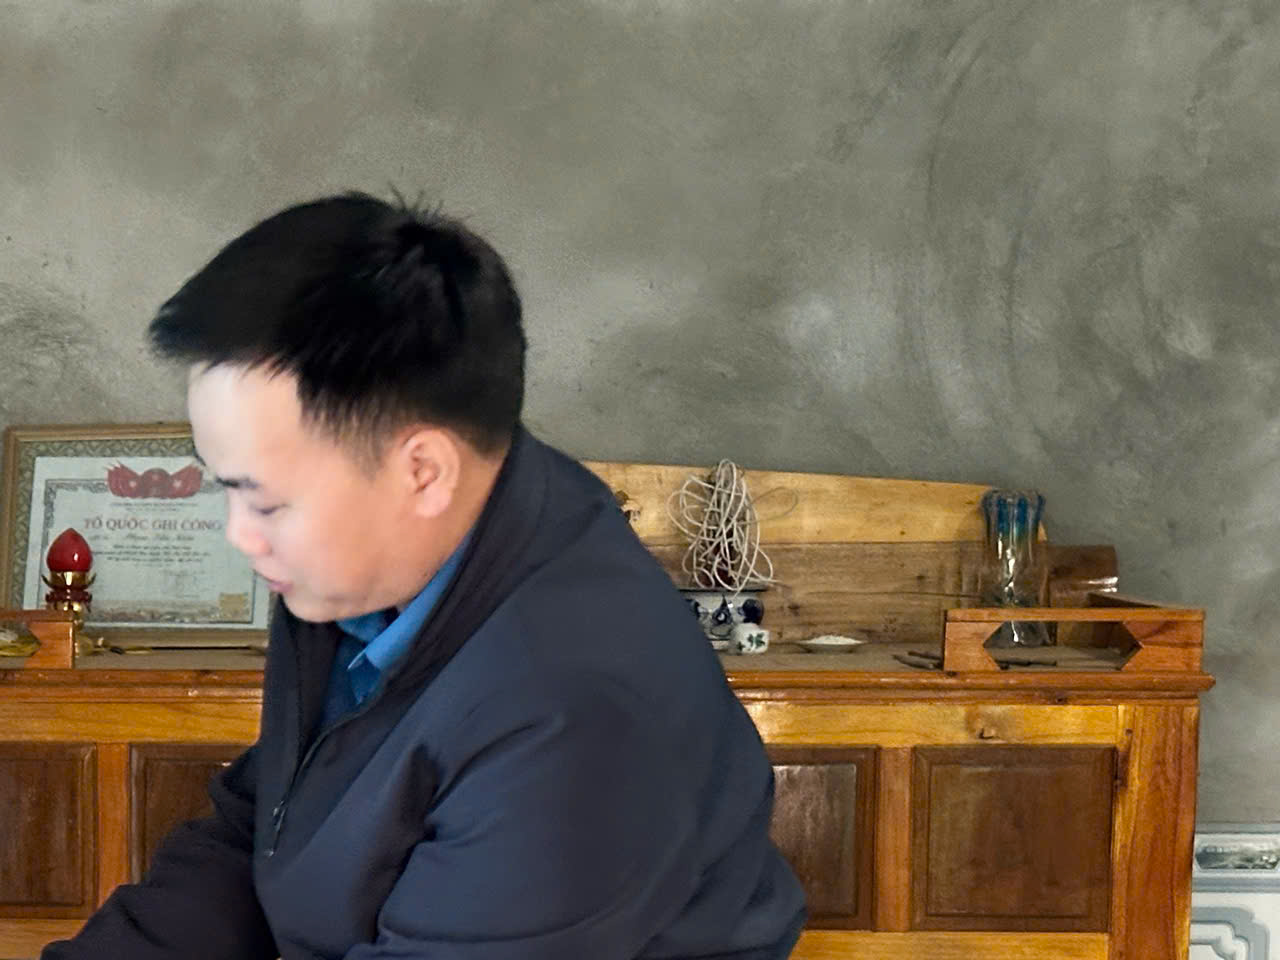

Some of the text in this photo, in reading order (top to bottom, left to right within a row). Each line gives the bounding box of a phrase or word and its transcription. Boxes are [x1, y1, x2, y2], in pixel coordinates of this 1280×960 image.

[84, 514, 222, 531] TỔ QUỐC GHI CÔNG
